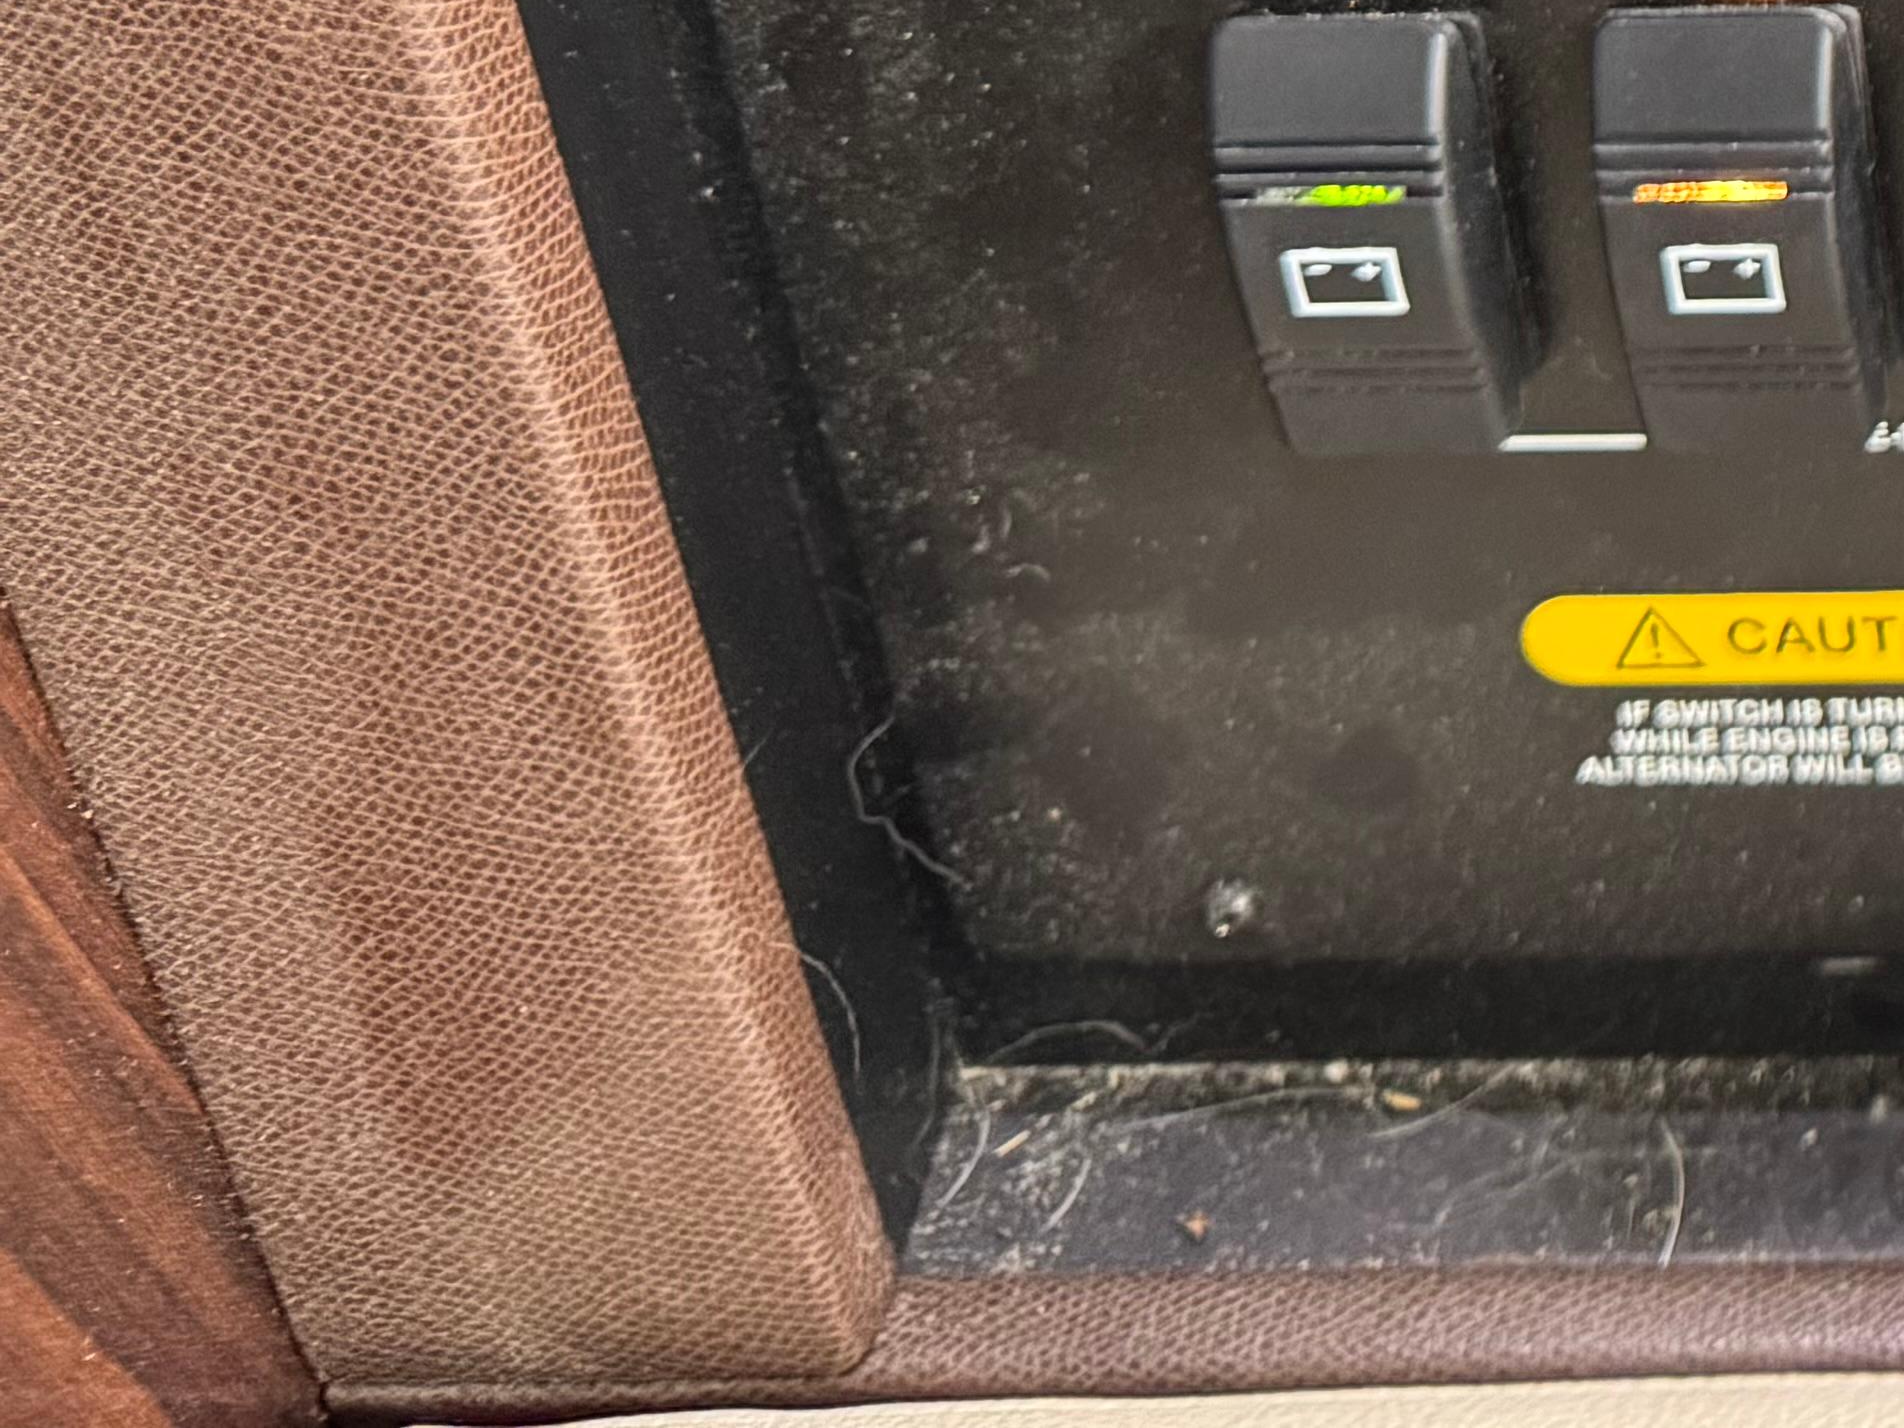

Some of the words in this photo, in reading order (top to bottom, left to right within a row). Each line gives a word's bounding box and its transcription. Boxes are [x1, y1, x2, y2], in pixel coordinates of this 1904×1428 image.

[1616, 700, 1651, 727] IF
[1653, 699, 1784, 727] SWITCH
[1788, 698, 1823, 726] IS
[1610, 727, 1721, 755] WHILE
[1722, 726, 1852, 755] ENGINE
[1856, 726, 1888, 754] IS
[1575, 755, 1789, 786] ALTERNATOR
[1791, 754, 1873, 784] WILL
